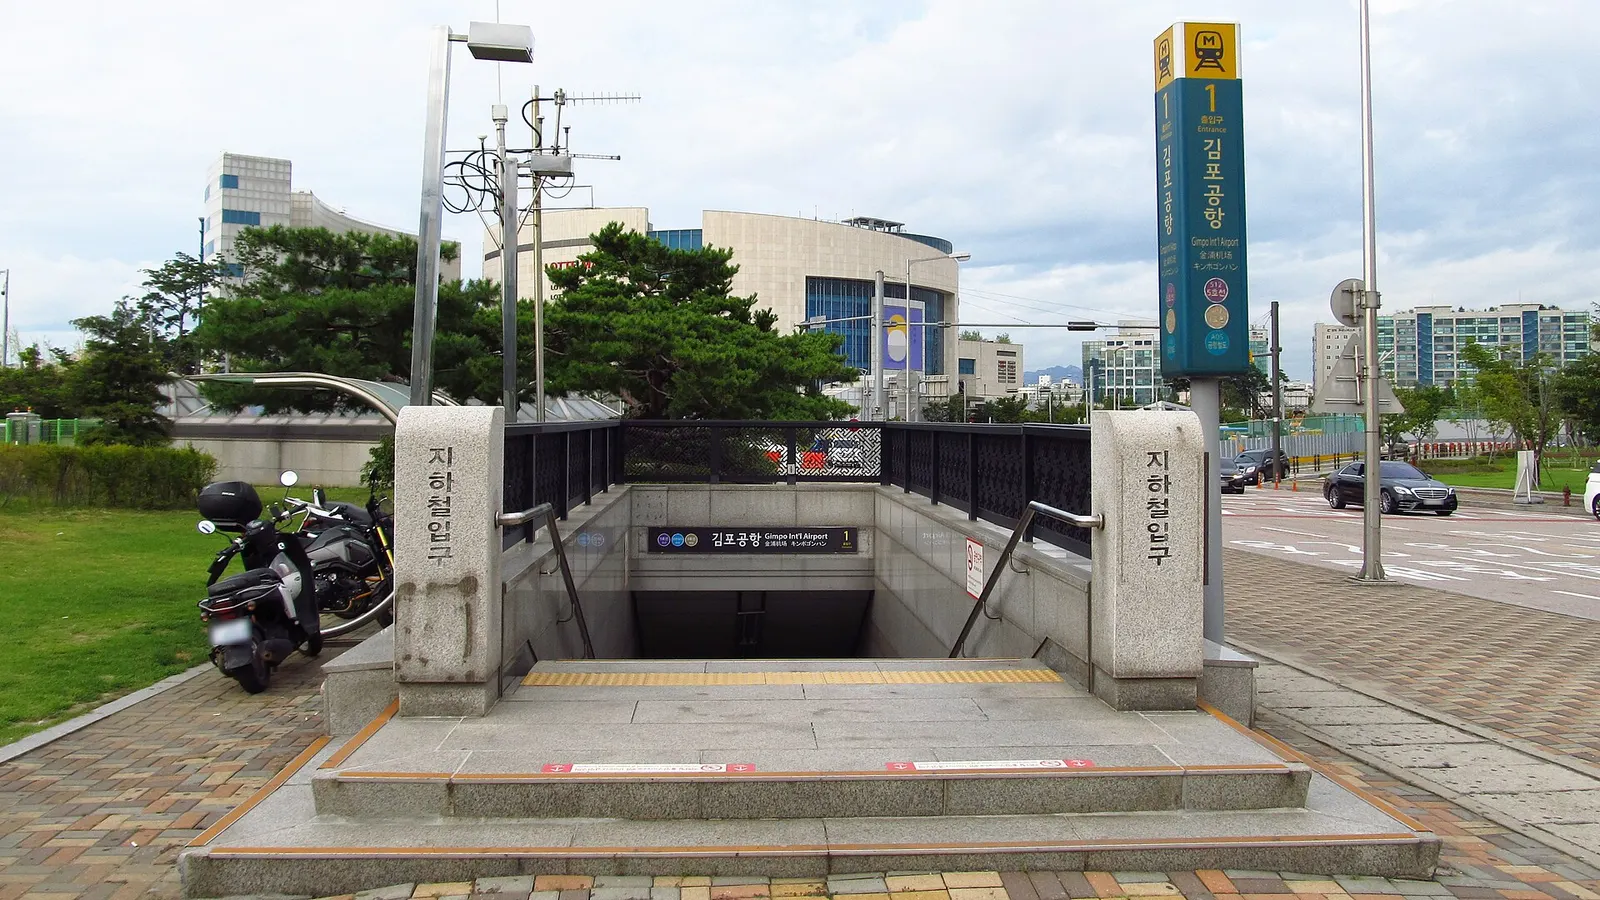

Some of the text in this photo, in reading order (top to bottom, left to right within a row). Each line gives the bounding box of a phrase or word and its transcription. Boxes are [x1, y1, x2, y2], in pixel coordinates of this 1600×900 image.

[1204, 83, 1216, 112] 1
[1162, 92, 1168, 119] 1
[1201, 115, 1224, 125] 출입구
[1197, 125, 1227, 133] Entrance
[1163, 144, 1173, 236] 김포공항
[1203, 138, 1225, 230] 김포공항
[1191, 236, 1209, 248] Gimpo
[1220, 236, 1239, 248] Airport
[1206, 289, 1226, 297] 5호선
[427, 446, 454, 567] 지하철입구
[1147, 450, 1172, 566] 지하철입구
[712, 532, 762, 547] 김포공항
[764, 532, 828, 541] Gimpo Int'l Airport
[843, 530, 849, 541] 1
